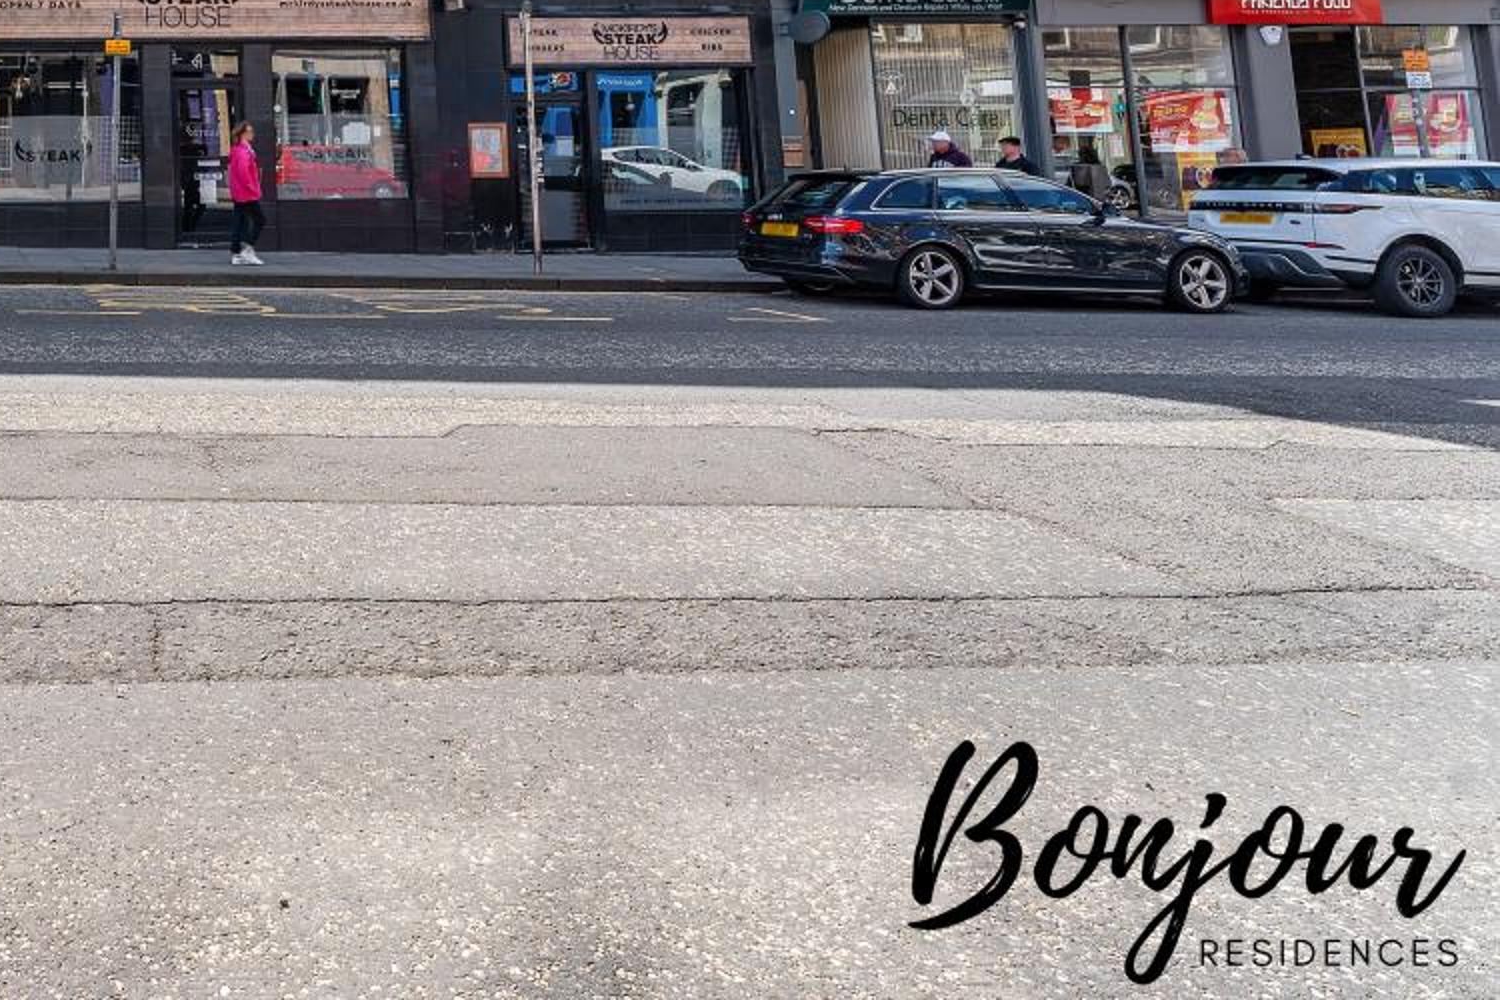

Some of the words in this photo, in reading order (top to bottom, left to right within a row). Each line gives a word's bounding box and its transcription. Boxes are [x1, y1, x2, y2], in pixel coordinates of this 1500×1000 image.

[0, 0, 33, 9] OPEN
[49, 0, 81, 9] DAYS
[146, 6, 231, 28] HOUSE
[603, 33, 656, 45] STEAK
[604, 46, 658, 60] HOUSE
[893, 106, 950, 127] Denta
[26, 148, 81, 163] STEAK
